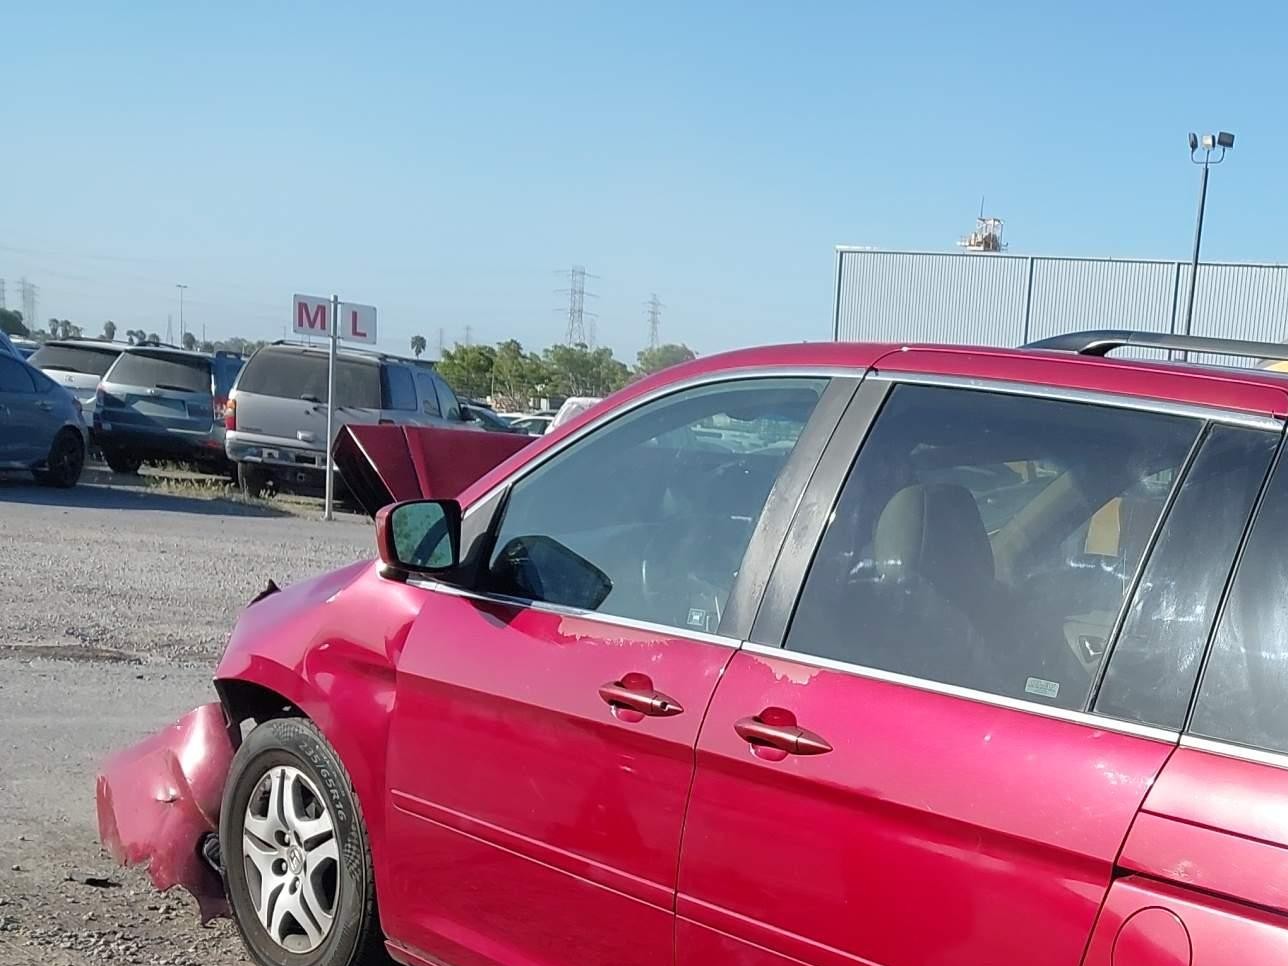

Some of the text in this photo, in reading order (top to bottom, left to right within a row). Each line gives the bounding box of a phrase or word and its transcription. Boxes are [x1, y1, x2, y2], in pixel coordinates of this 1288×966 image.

[297, 301, 327, 331] M
[351, 310, 367, 338] L
[299, 743, 347, 821] 235/65R16
